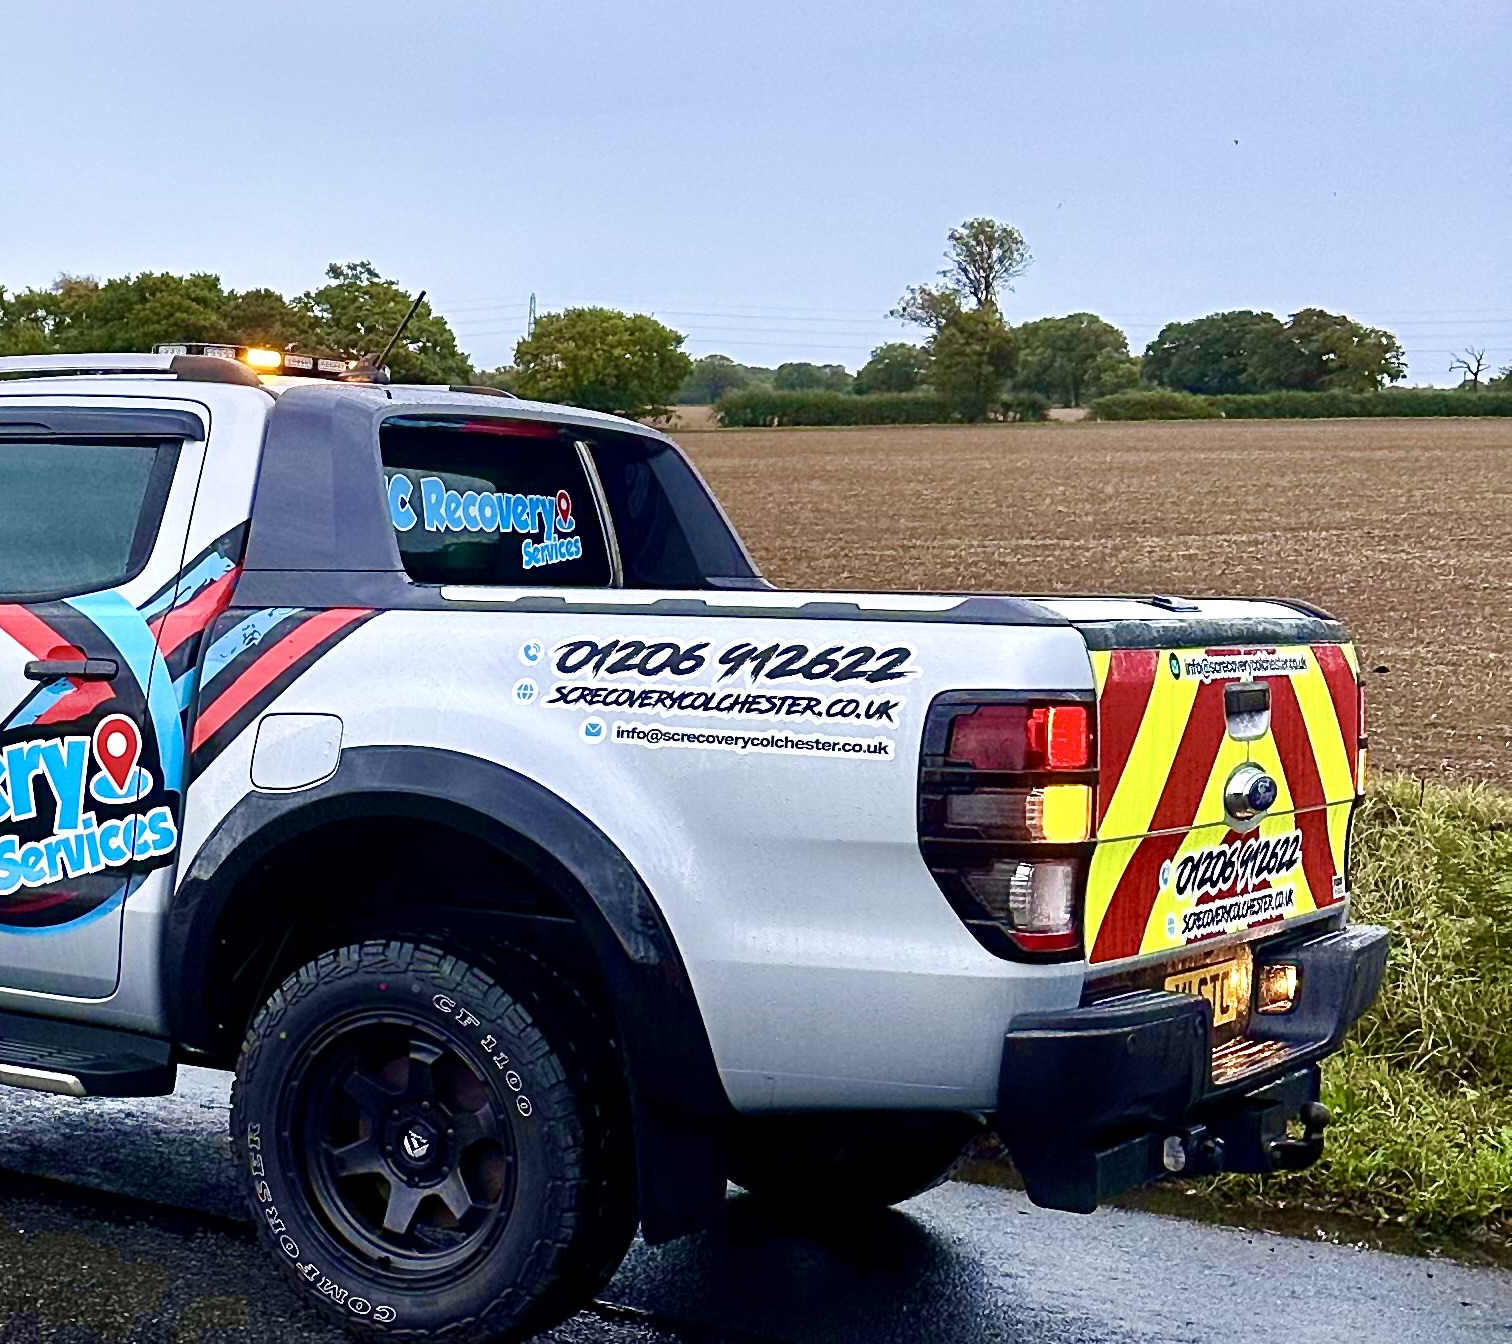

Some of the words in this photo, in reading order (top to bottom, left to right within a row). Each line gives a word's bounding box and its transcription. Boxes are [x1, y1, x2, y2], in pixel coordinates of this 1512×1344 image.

[384, 474, 417, 531] C
[420, 476, 555, 541] Recovery
[522, 536, 582, 569] Services
[553, 639, 712, 682] 01206
[715, 642, 918, 687] 912622
[547, 686, 902, 722] SCRECOVERYCOLCHESTER.CO.UK
[616, 725, 889, 755] info@screcoverycolchester.co.uk
[1176, 844, 1239, 896] 01206
[1237, 834, 1300, 891] 912622
[431, 994, 480, 1027] CF
[480, 1034, 533, 1117] 1100
[247, 1122, 397, 1323] COMFORSER
